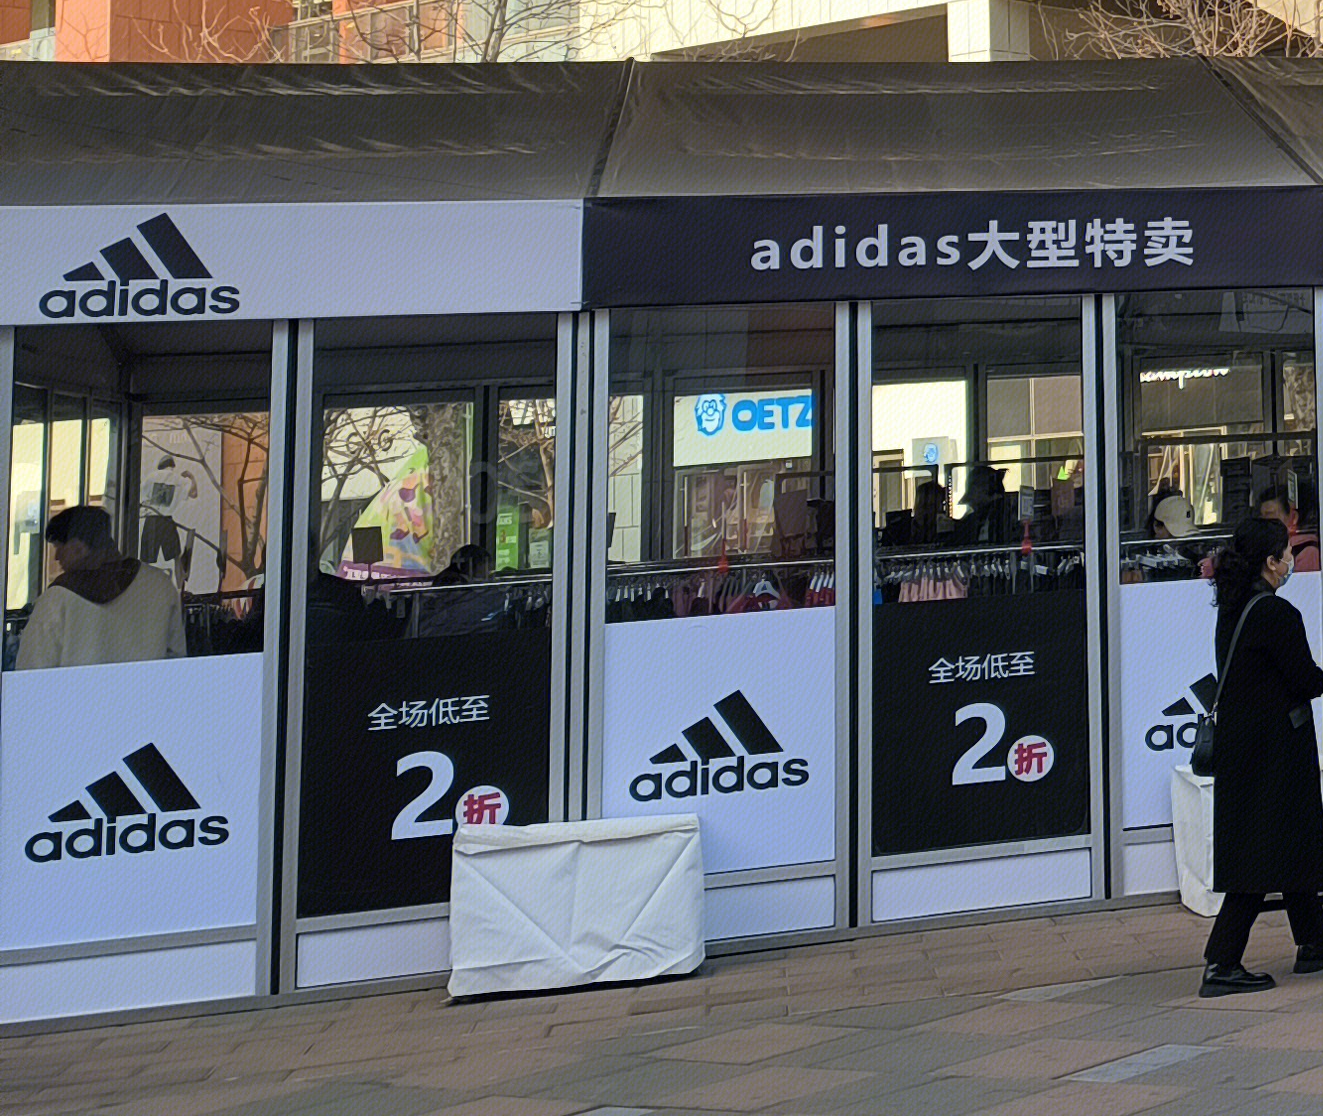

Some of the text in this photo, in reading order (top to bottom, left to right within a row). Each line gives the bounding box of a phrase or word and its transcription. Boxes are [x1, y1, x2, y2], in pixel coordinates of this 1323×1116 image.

[750, 217, 1195, 271] adidas大型特卖
[38, 279, 240, 318] adidas
[928, 651, 1036, 684] 全场低至
[368, 695, 491, 731] 全场低至
[629, 755, 810, 802] adidas
[24, 812, 230, 863] adidas
